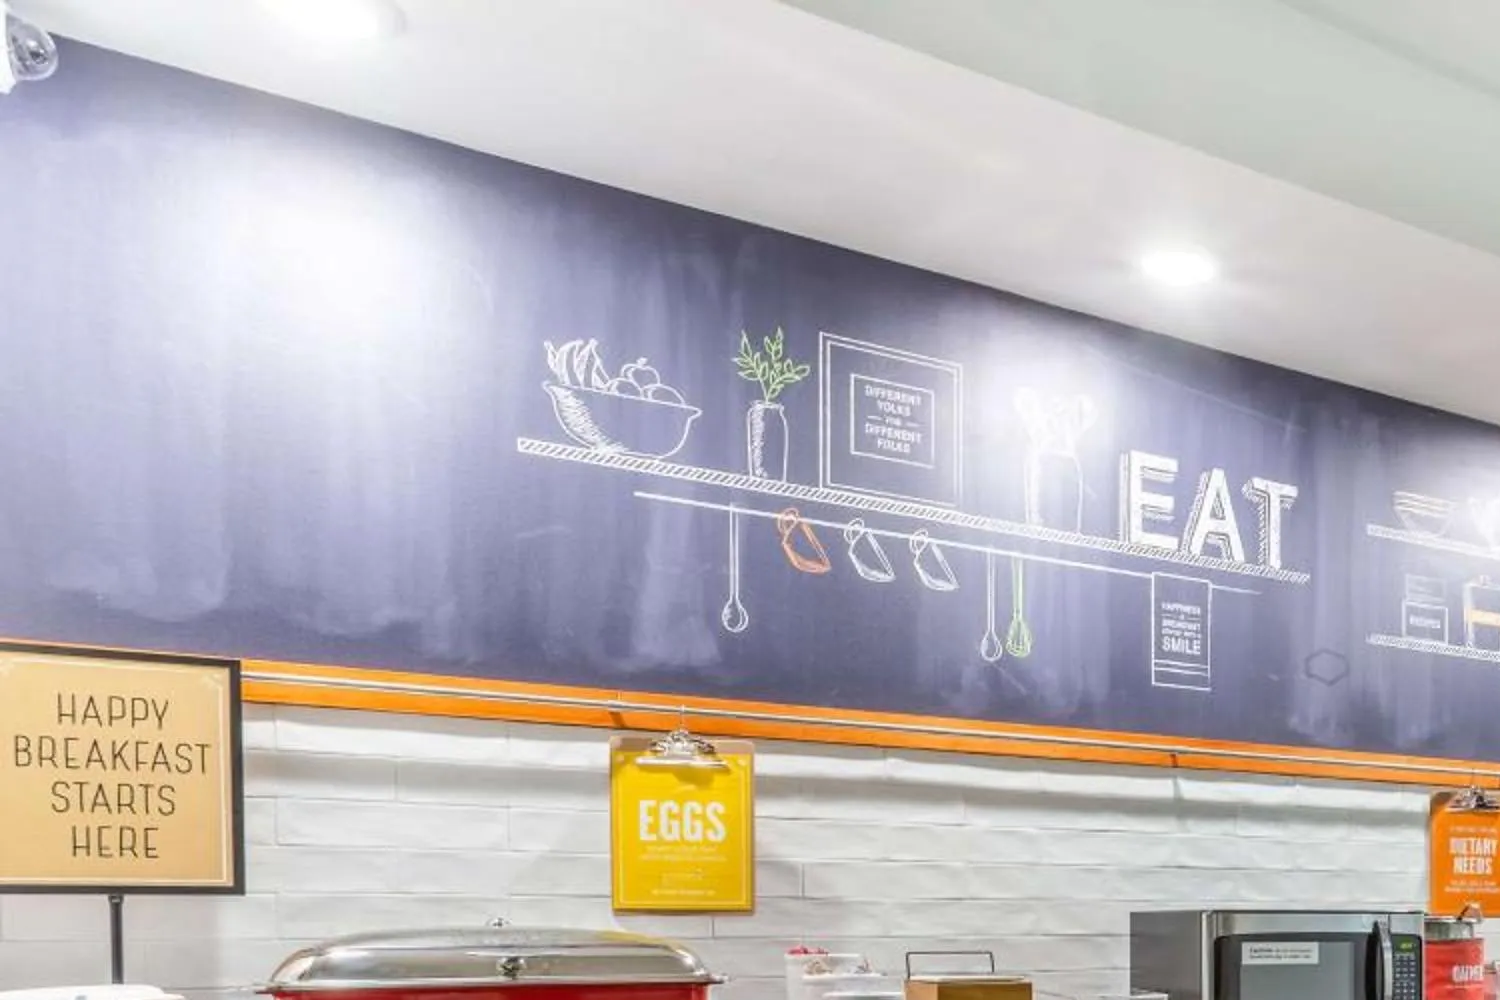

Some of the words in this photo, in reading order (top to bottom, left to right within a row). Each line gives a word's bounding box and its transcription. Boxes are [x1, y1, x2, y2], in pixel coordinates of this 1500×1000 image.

[864, 384, 921, 406] DIFFERENT
[864, 422, 921, 444] DIFFERENT
[1120, 450, 1299, 569] EAT
[1161, 635, 1201, 655] SMILE
[57, 692, 169, 731] HAPPY
[14, 734, 212, 775] BREAKFAST
[51, 781, 177, 817] STARTS
[639, 799, 727, 842] EGGS
[71, 824, 161, 859] HERE
[1449, 836, 1498, 857] DIETARY
[1453, 856, 1493, 875] NEEDS
